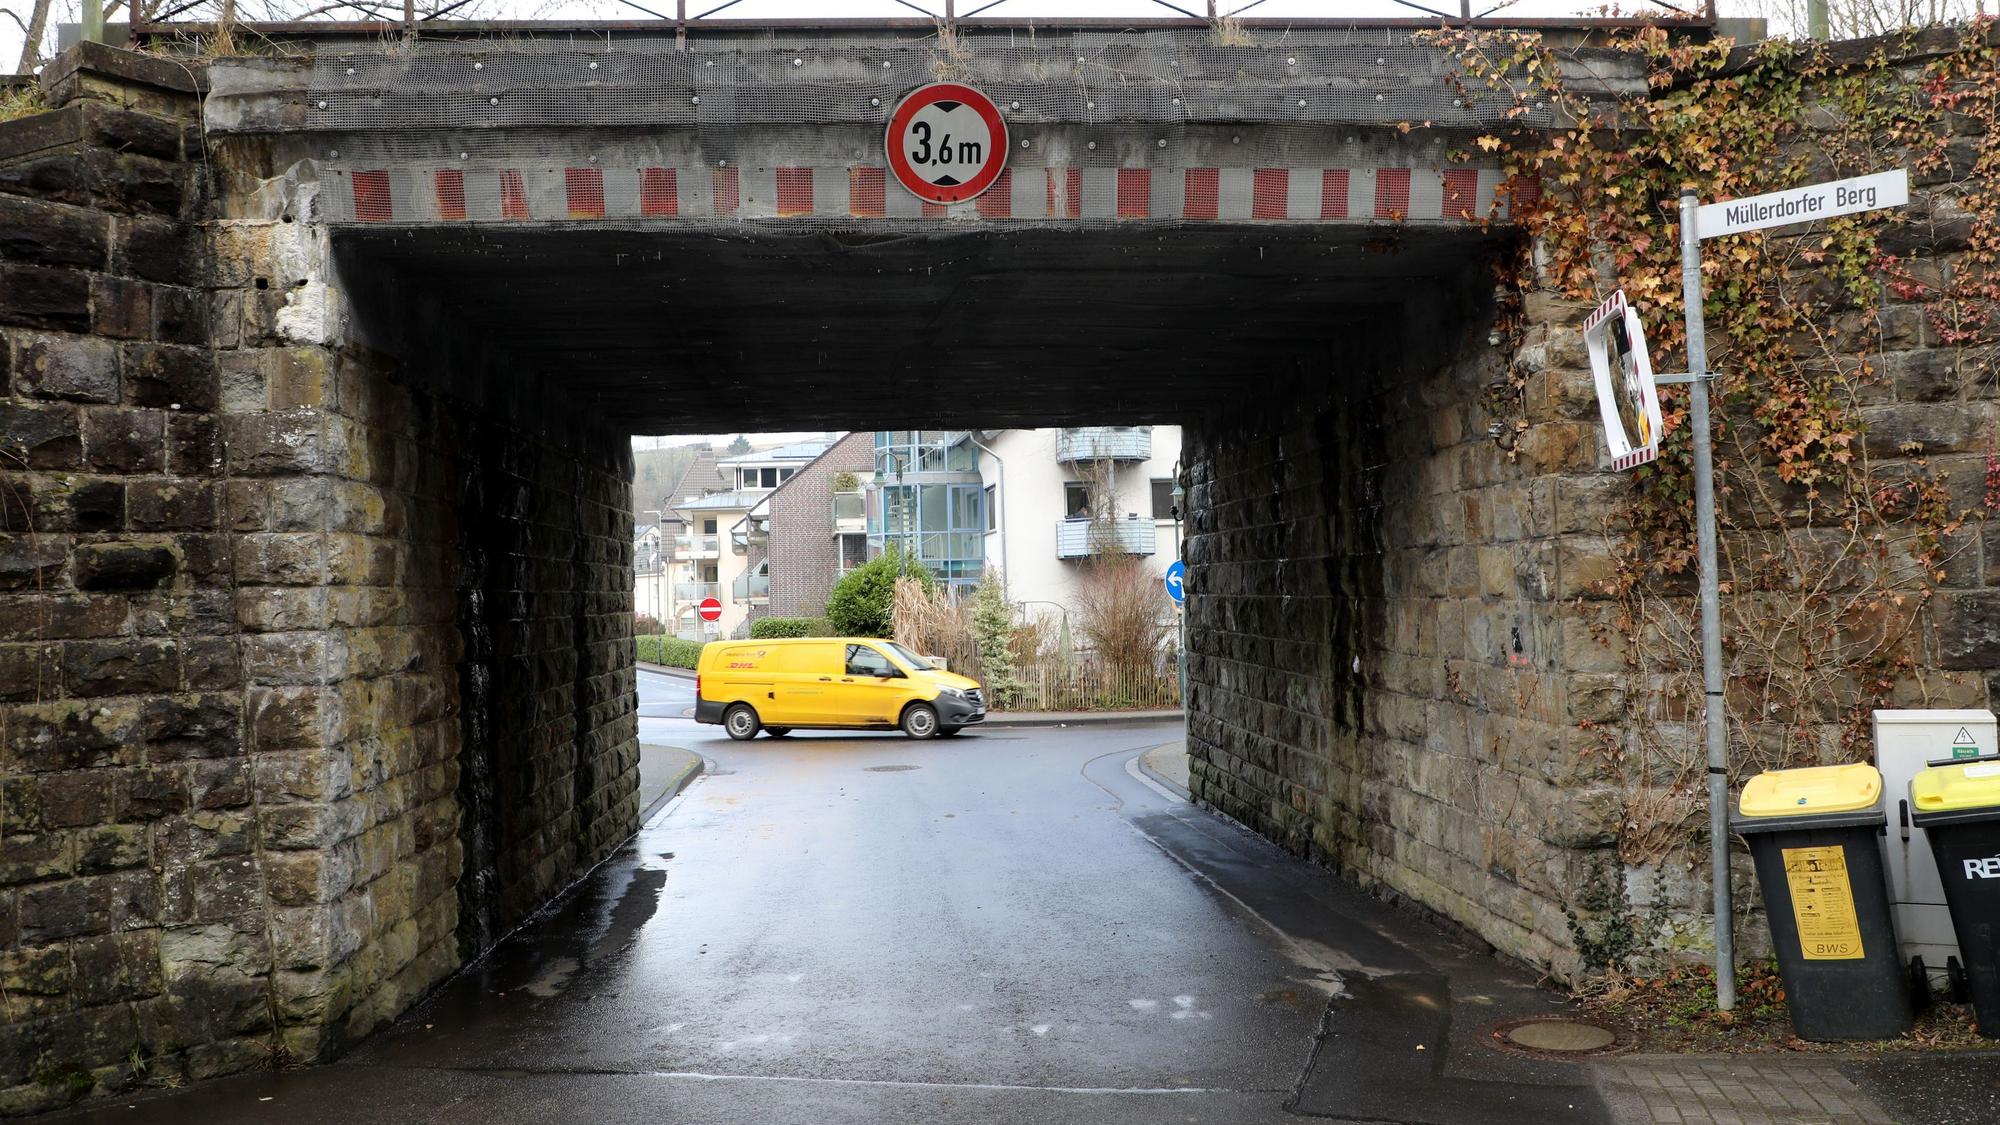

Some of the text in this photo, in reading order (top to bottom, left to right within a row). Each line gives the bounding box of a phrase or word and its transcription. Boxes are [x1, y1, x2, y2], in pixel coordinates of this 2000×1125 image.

[1726, 186, 1877, 227] Müllerdorfer Berg
[1963, 857, 2000, 880] RE
[1816, 943, 1849, 954] BWS
